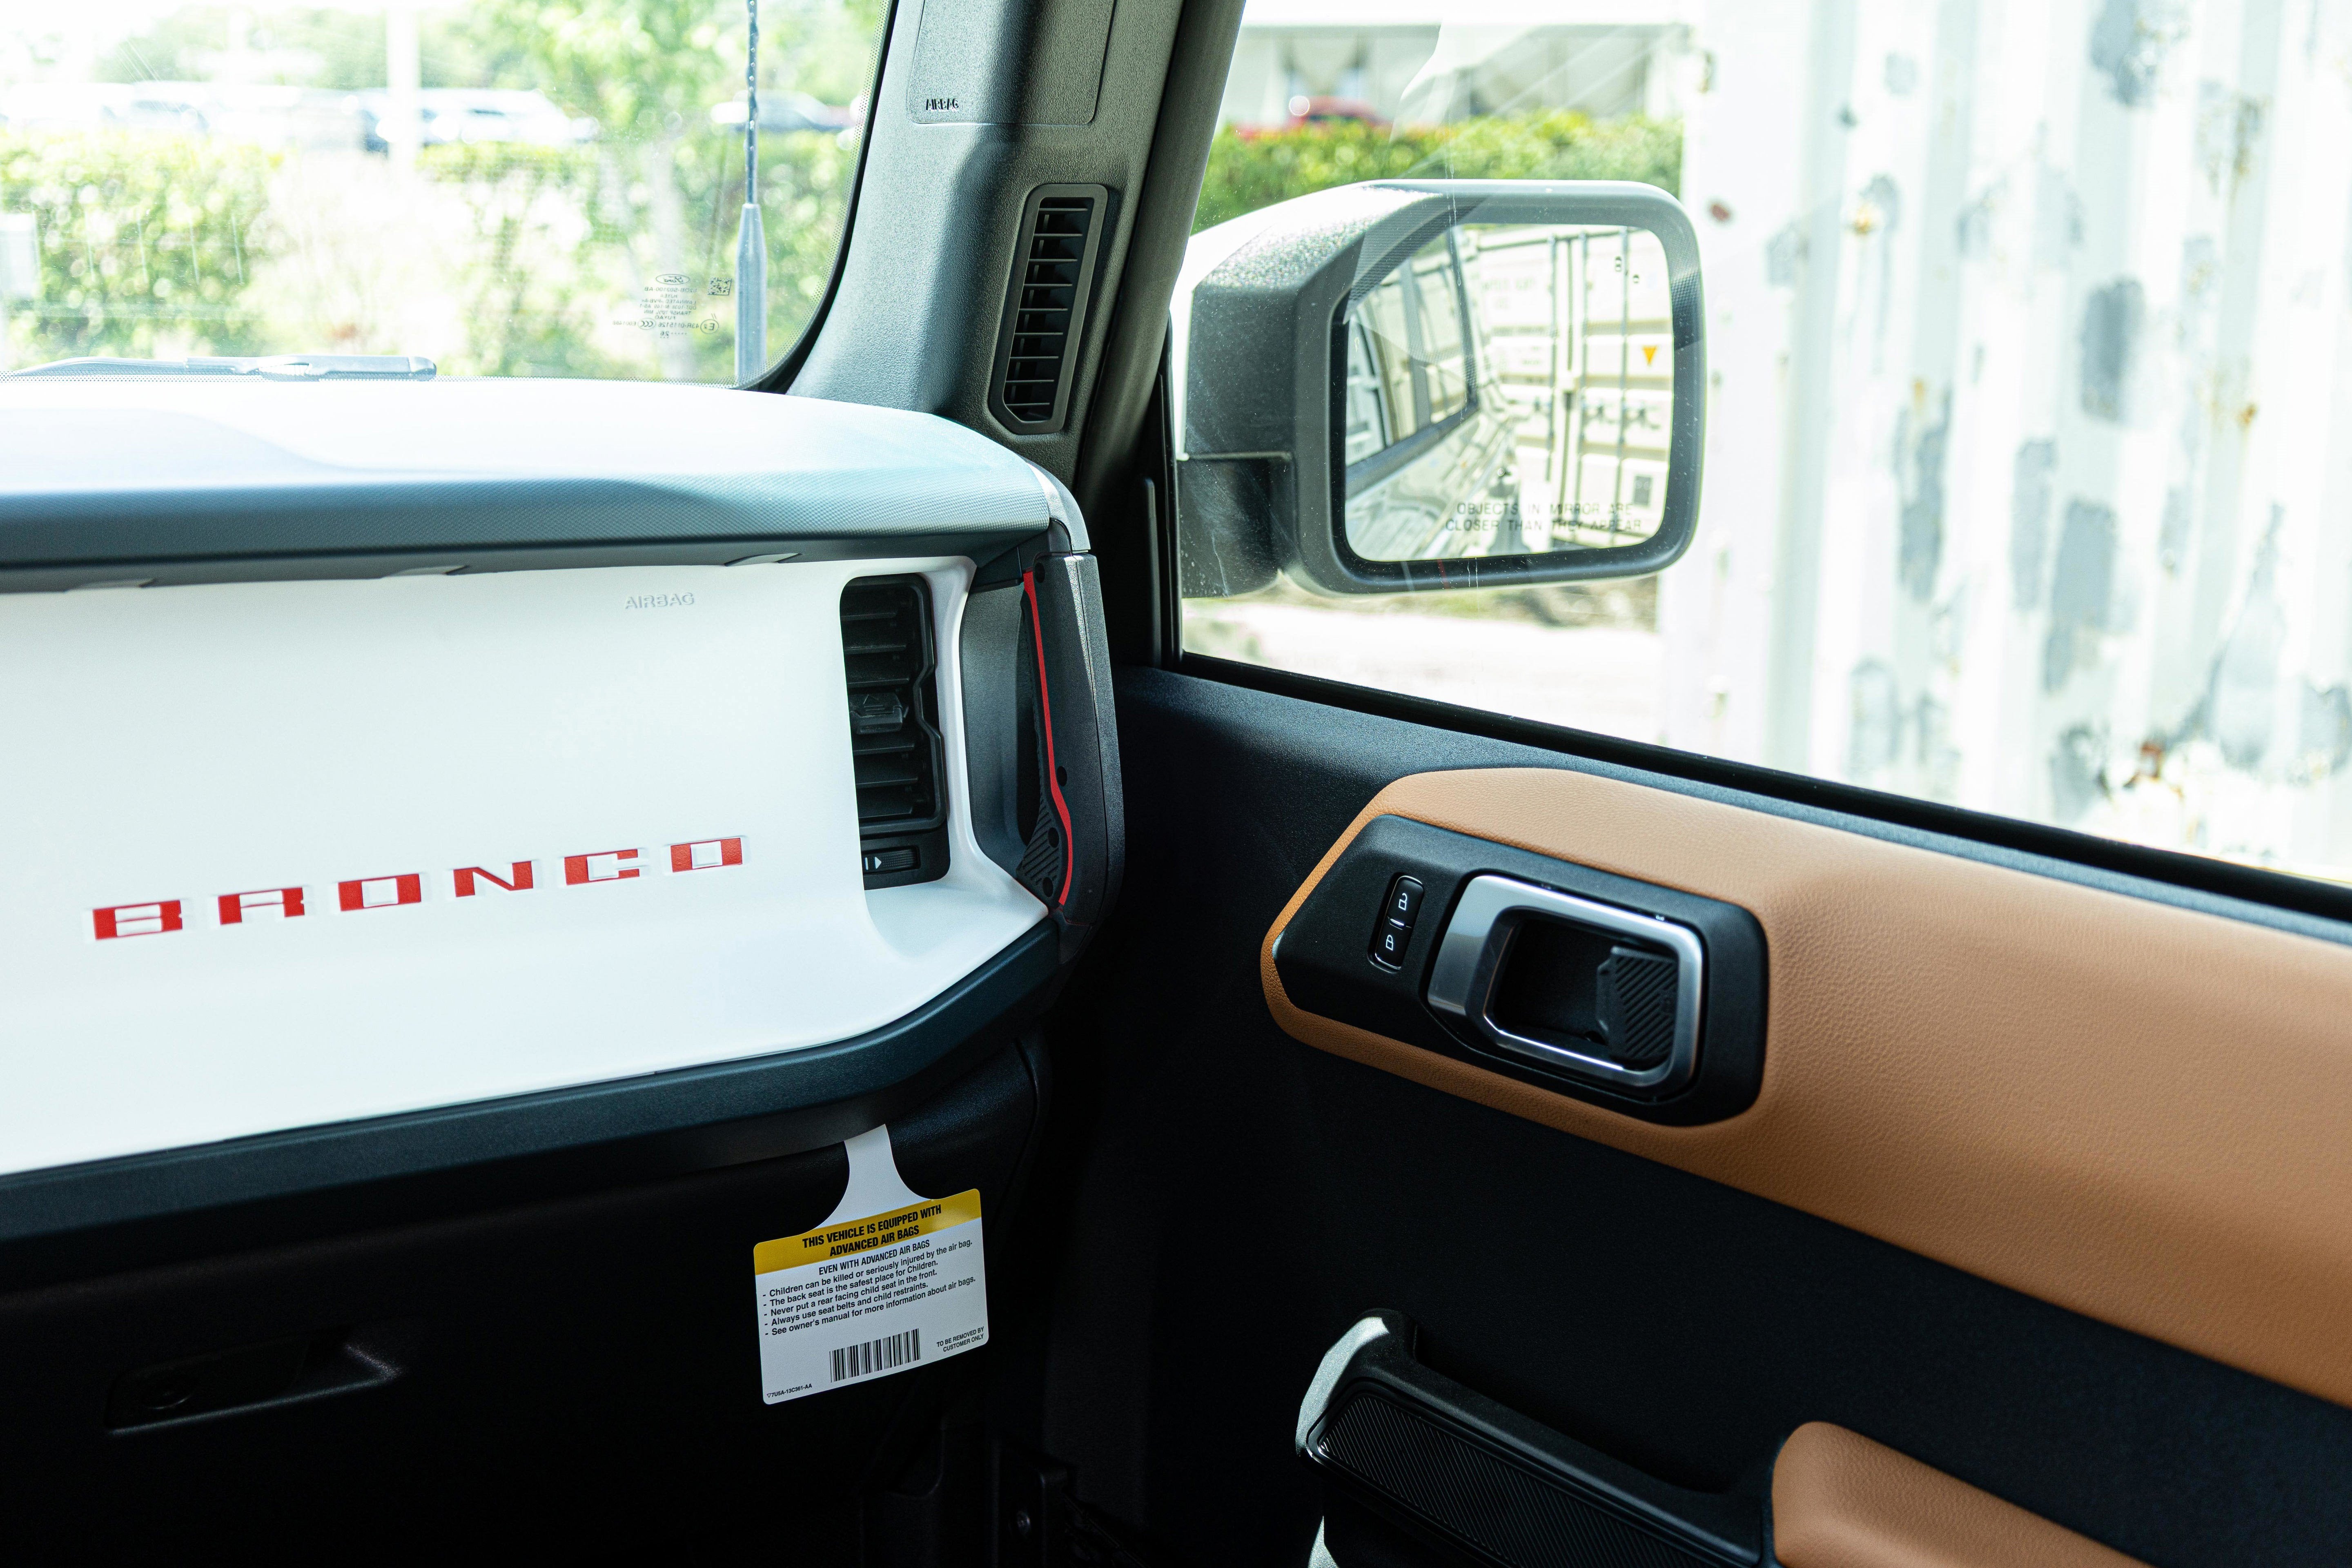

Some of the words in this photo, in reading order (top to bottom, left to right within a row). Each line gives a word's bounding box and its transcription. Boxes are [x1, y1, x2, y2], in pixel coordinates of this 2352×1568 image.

[925, 98, 959, 111] AIRBAG
[1445, 518, 1500, 532] CLOSER
[1507, 519, 1543, 532] THAN
[1552, 519, 1583, 532] THEY
[1590, 519, 1642, 532] APPEAR
[1457, 502, 1519, 515] OBJECTS
[1528, 502, 1540, 514] IN
[1550, 502, 1600, 514] MIRROR
[1607, 502, 1633, 514] ARE
[625, 592, 695, 609] AIRBAG
[91, 835, 745, 941] BRONCO
[802, 1235, 824, 1248] THIS
[826, 1226, 865, 1243] VEHICLE
[866, 1223, 876, 1234] IS
[878, 1212, 918, 1232] EQUIPPED
[920, 1204, 942, 1219] WITH
[829, 1237, 879, 1257] ADVANCED
[880, 1232, 895, 1245] AIR
[897, 1225, 920, 1240] BAGS
[769, 1285, 803, 1297] Children
[833, 1272, 854, 1283] killed
[866, 1261, 899, 1274] seriously
[900, 1253, 924, 1266] injured
[949, 1243, 957, 1252] air
[958, 1240, 973, 1249] bag.
[819, 1264, 838, 1276] EVEN
[840, 1259, 859, 1270] WITH
[861, 1249, 898, 1266] ADVANCED
[899, 1245, 911, 1256] AIR
[912, 1240, 930, 1252] BAGS
[769, 1298, 785, 1307] The
[787, 1293, 806, 1303] back
[808, 1289, 824, 1298] seat
[849, 1277, 873, 1289] safest
[875, 1273, 894, 1285] place
[895, 1268, 906, 1277] for
[907, 1261, 938, 1274] Children.
[771, 1306, 794, 1316] Never
[796, 1302, 809, 1313] put
[817, 1297, 833, 1306] rear
[834, 1291, 859, 1302] facing
[860, 1283, 879, 1296] child
[881, 1281, 896, 1291] seat
[906, 1276, 918, 1284] the
[918, 1269, 937, 1280] front.
[771, 1312, 800, 1326] Always
[802, 1311, 816, 1319] use
[818, 1305, 835, 1315] seat
[836, 1297, 857, 1311] belts
[857, 1296, 872, 1306] and
[873, 1291, 891, 1302] child
[893, 1283, 928, 1297] restraints.
[771, 1327, 787, 1336] See
[788, 1319, 820, 1332] owner's
[821, 1307, 850, 1324] manual
[851, 1304, 863, 1314] for
[864, 1298, 885, 1311] more
[886, 1290, 926, 1306] information
[927, 1285, 947, 1296] about
[948, 1282, 957, 1290] air
[958, 1277, 976, 1287] bags.
[943, 1339, 971, 1352] CUSTOMER
[971, 1334, 984, 1342] ONLY
[953, 1330, 977, 1342] REMOVED
